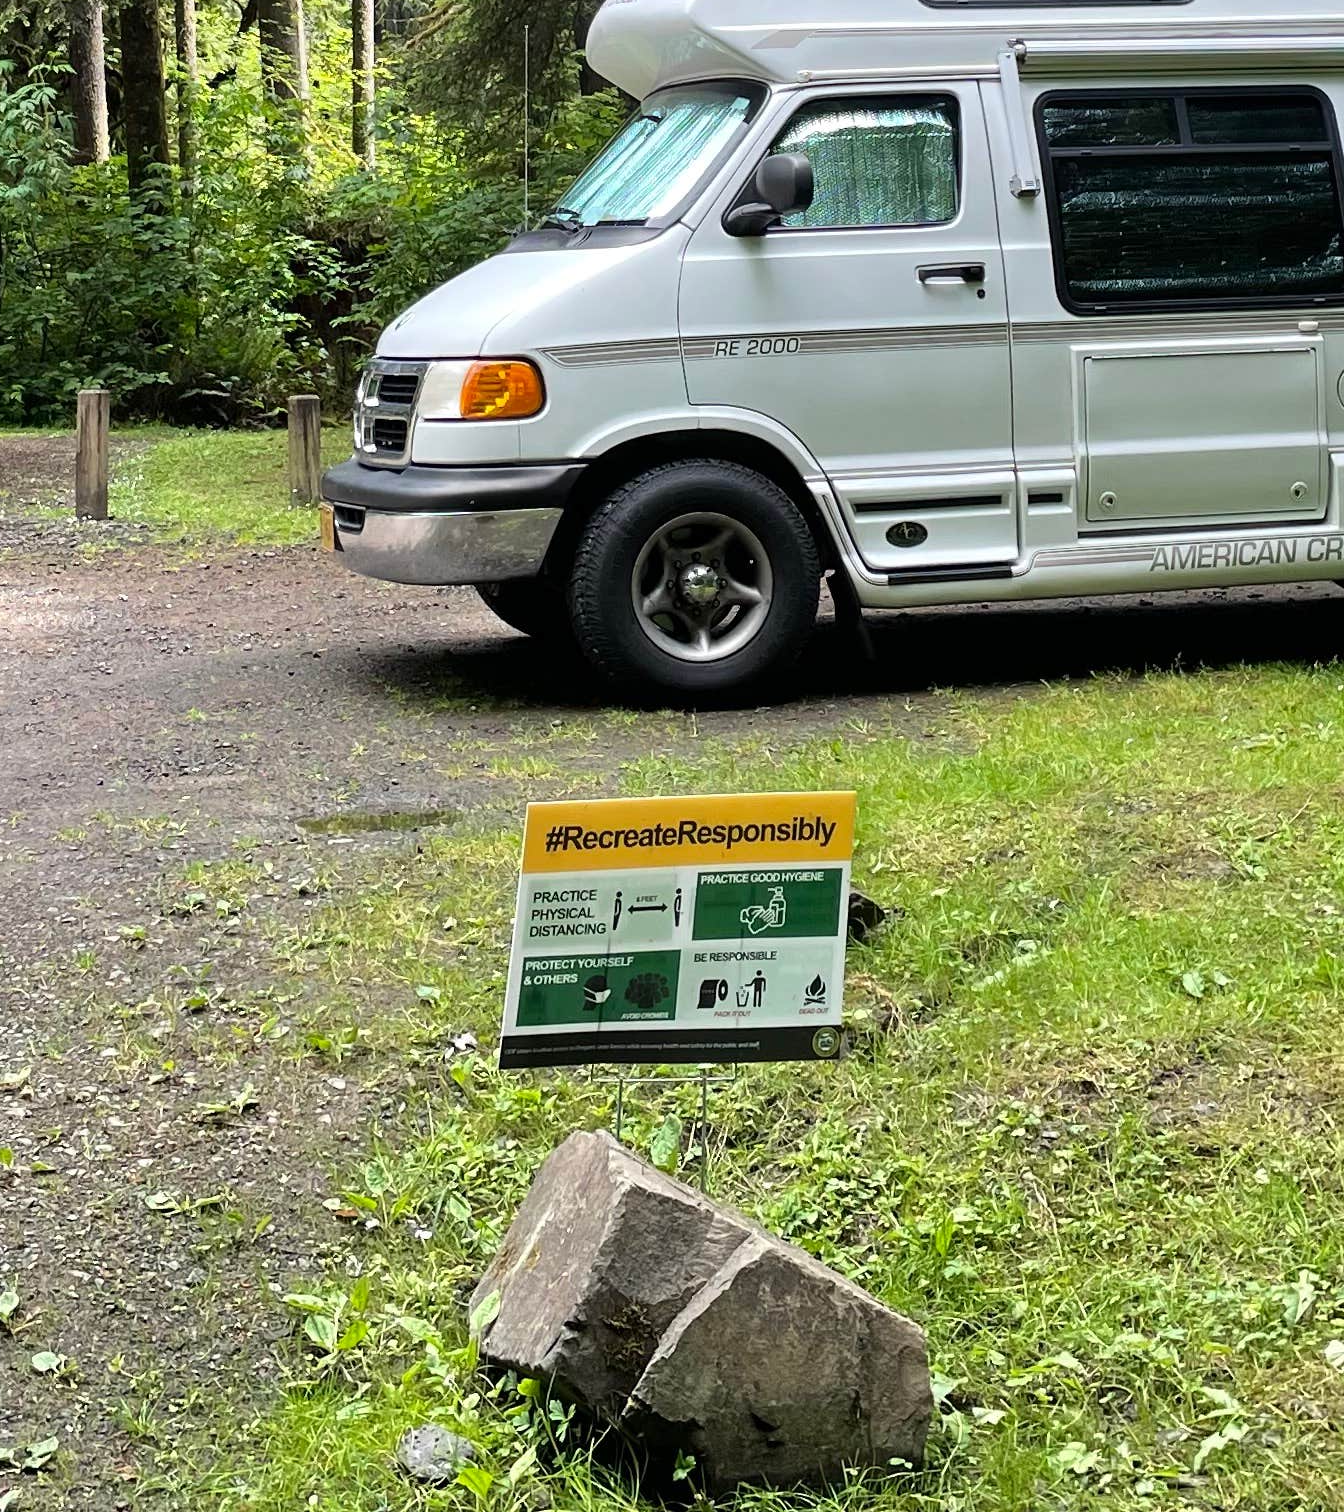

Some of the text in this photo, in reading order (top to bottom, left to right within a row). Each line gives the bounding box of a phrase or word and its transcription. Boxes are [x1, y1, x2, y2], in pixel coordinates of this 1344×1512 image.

[715, 337, 799, 356] RE 2000
[1150, 539, 1297, 572] AMERICAN
[545, 816, 837, 852] #RecreateResponsibly
[700, 871, 825, 885] PRACTICE GOOD HYGIENE
[533, 889, 598, 904] PRACTICE
[531, 907, 595, 921] PHYSICAL
[529, 923, 607, 937] DISTANCING
[525, 956, 634, 971] PROTECT YOURSELF
[694, 950, 778, 963] BE RESPONSIBLE
[523, 974, 579, 986] & OTHERS
